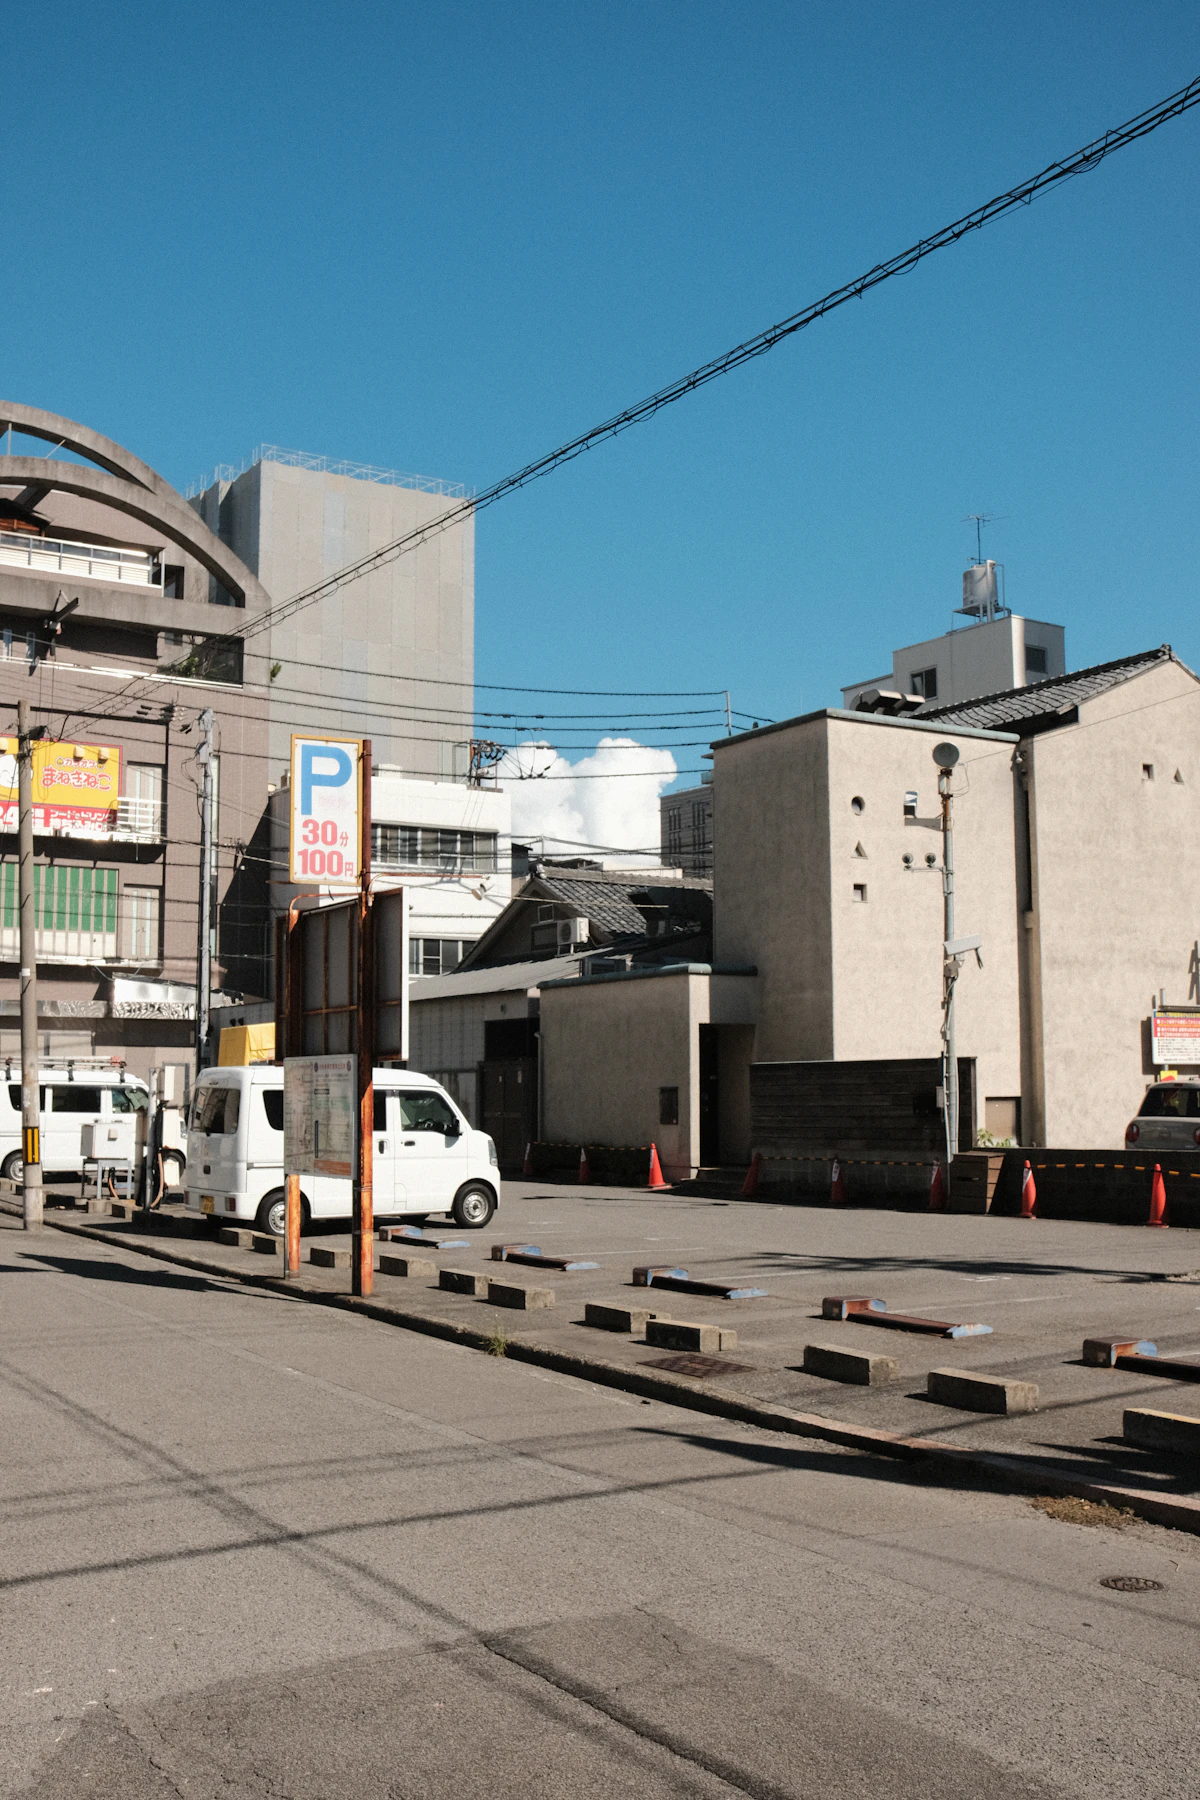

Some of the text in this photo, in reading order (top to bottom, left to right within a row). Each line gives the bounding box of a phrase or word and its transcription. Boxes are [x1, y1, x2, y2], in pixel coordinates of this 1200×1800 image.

[41, 766, 112, 792] まねきねこ
[301, 744, 353, 815] P
[0, 805, 19, 834] 4
[302, 818, 349, 847] 30分
[298, 848, 354, 877] 100円
